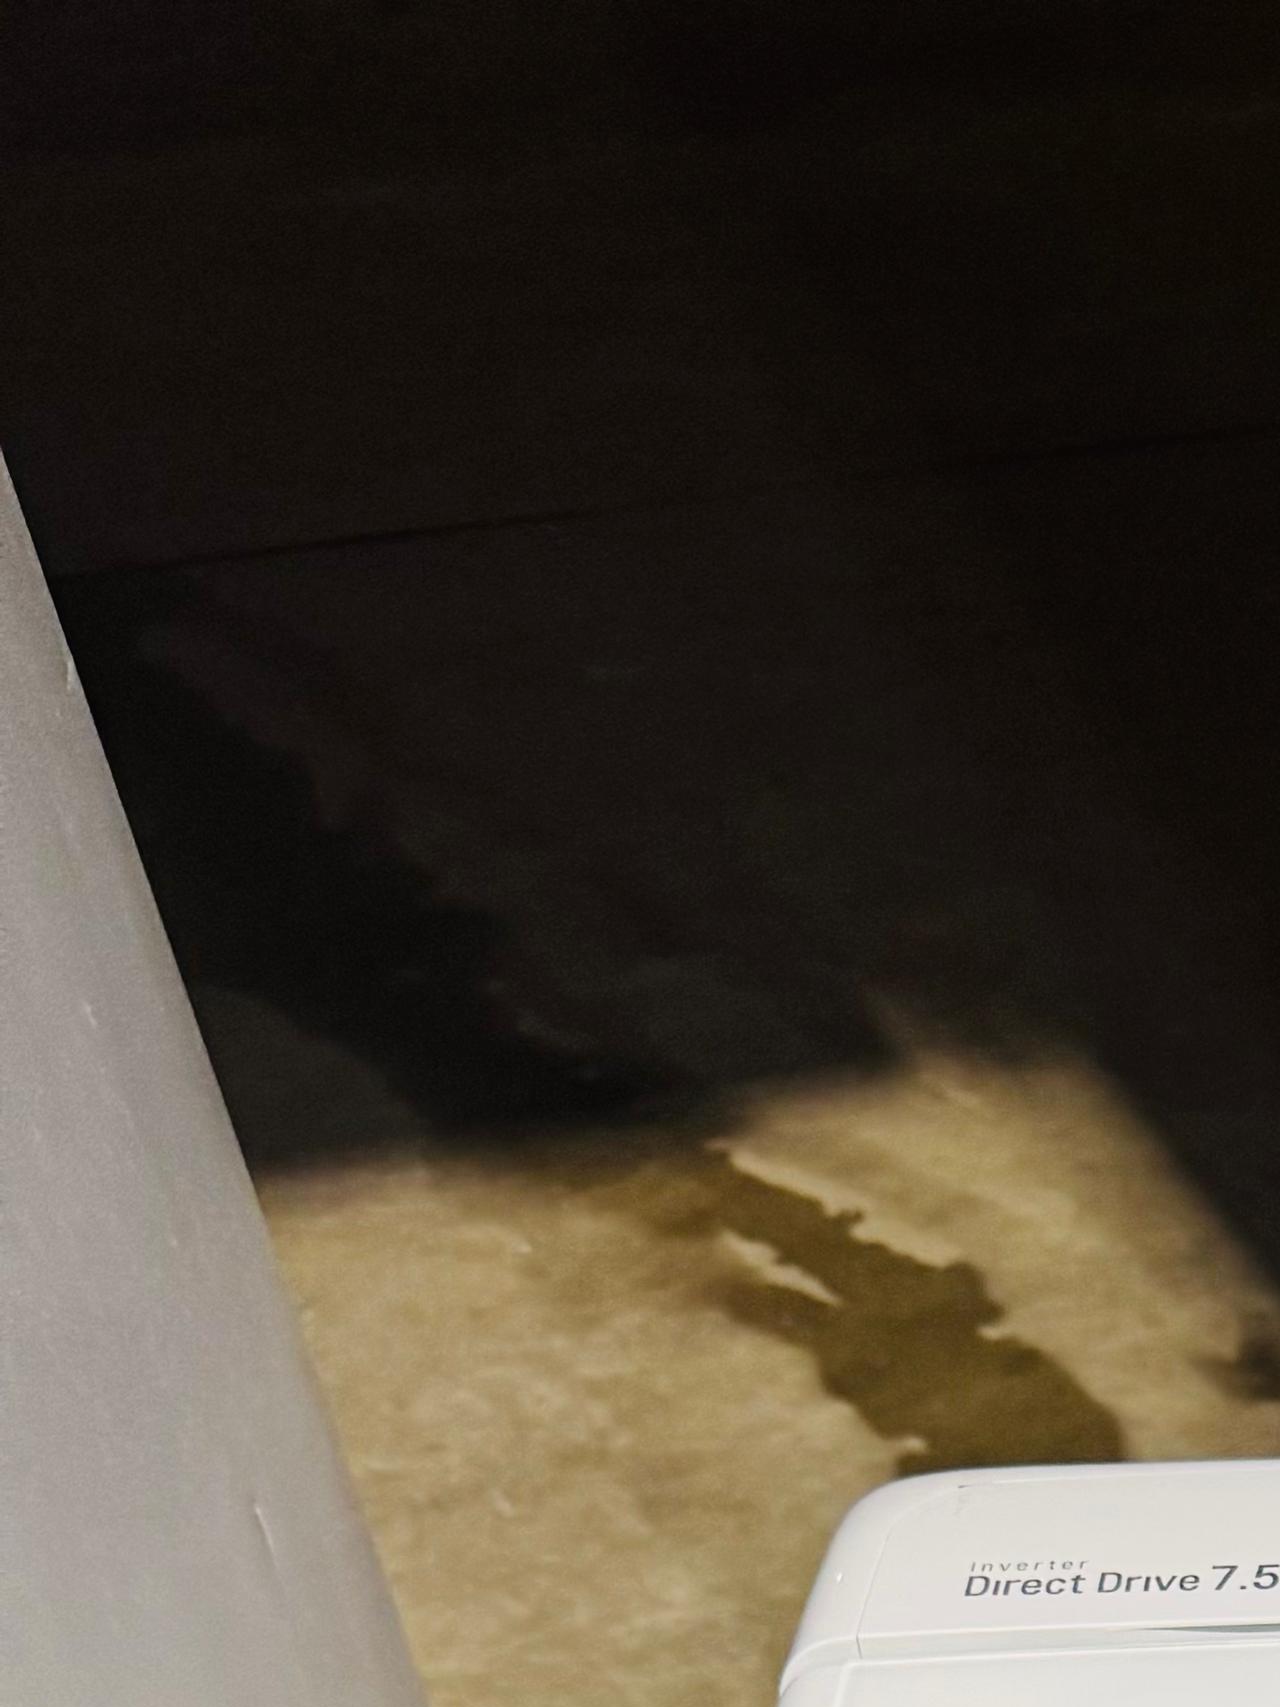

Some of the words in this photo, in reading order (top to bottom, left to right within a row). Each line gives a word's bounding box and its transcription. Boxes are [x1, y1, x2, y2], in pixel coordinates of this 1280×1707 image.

[971, 1560, 1089, 1572] Inverter
[965, 1574, 1086, 1596] Direct
[1098, 1572, 1200, 1594] Drive
